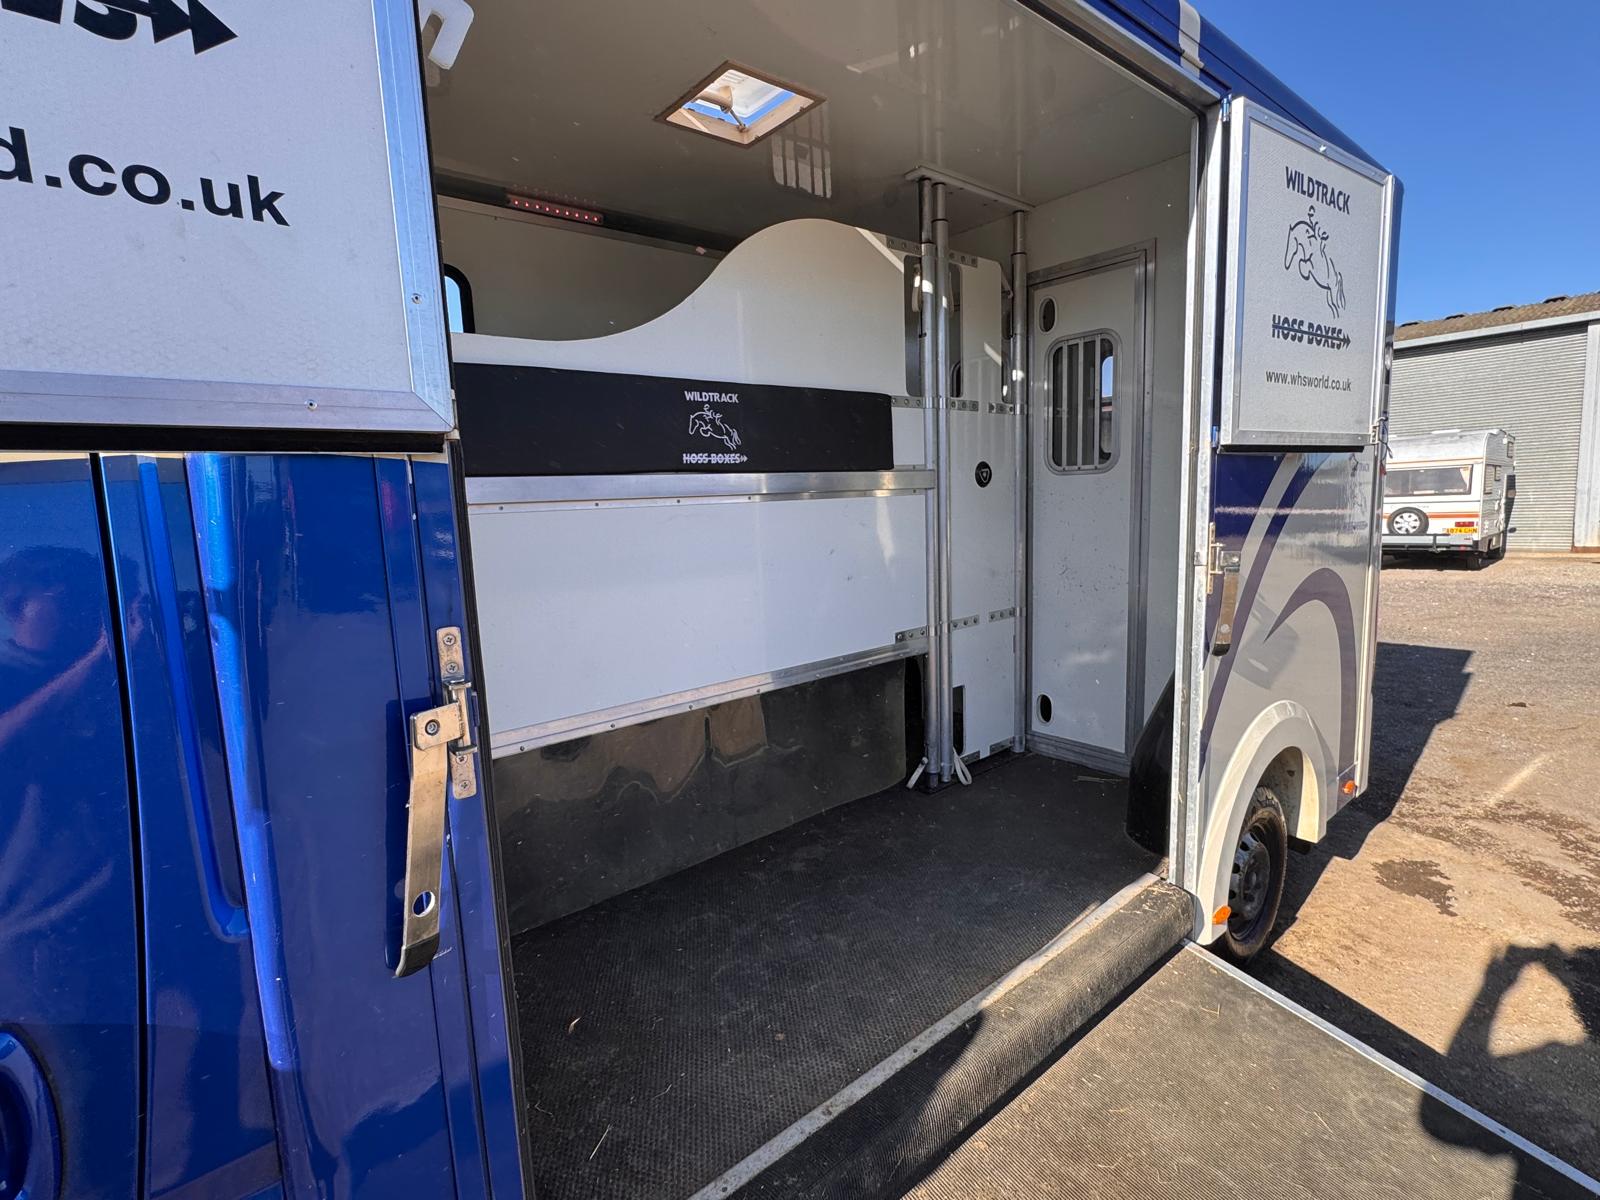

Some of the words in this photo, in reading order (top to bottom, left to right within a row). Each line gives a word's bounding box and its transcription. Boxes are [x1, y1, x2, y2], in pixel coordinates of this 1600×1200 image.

[1285, 166, 1350, 214] WILDTRACK
[1271, 314, 1304, 343] HOSS
[1307, 322, 1343, 350] BOXES
[1265, 371, 1351, 391] www.whsworld.co.uk
[684, 390, 739, 403] WILDTRACK
[683, 453, 708, 464] HOSS
[710, 453, 741, 464] BOXES
